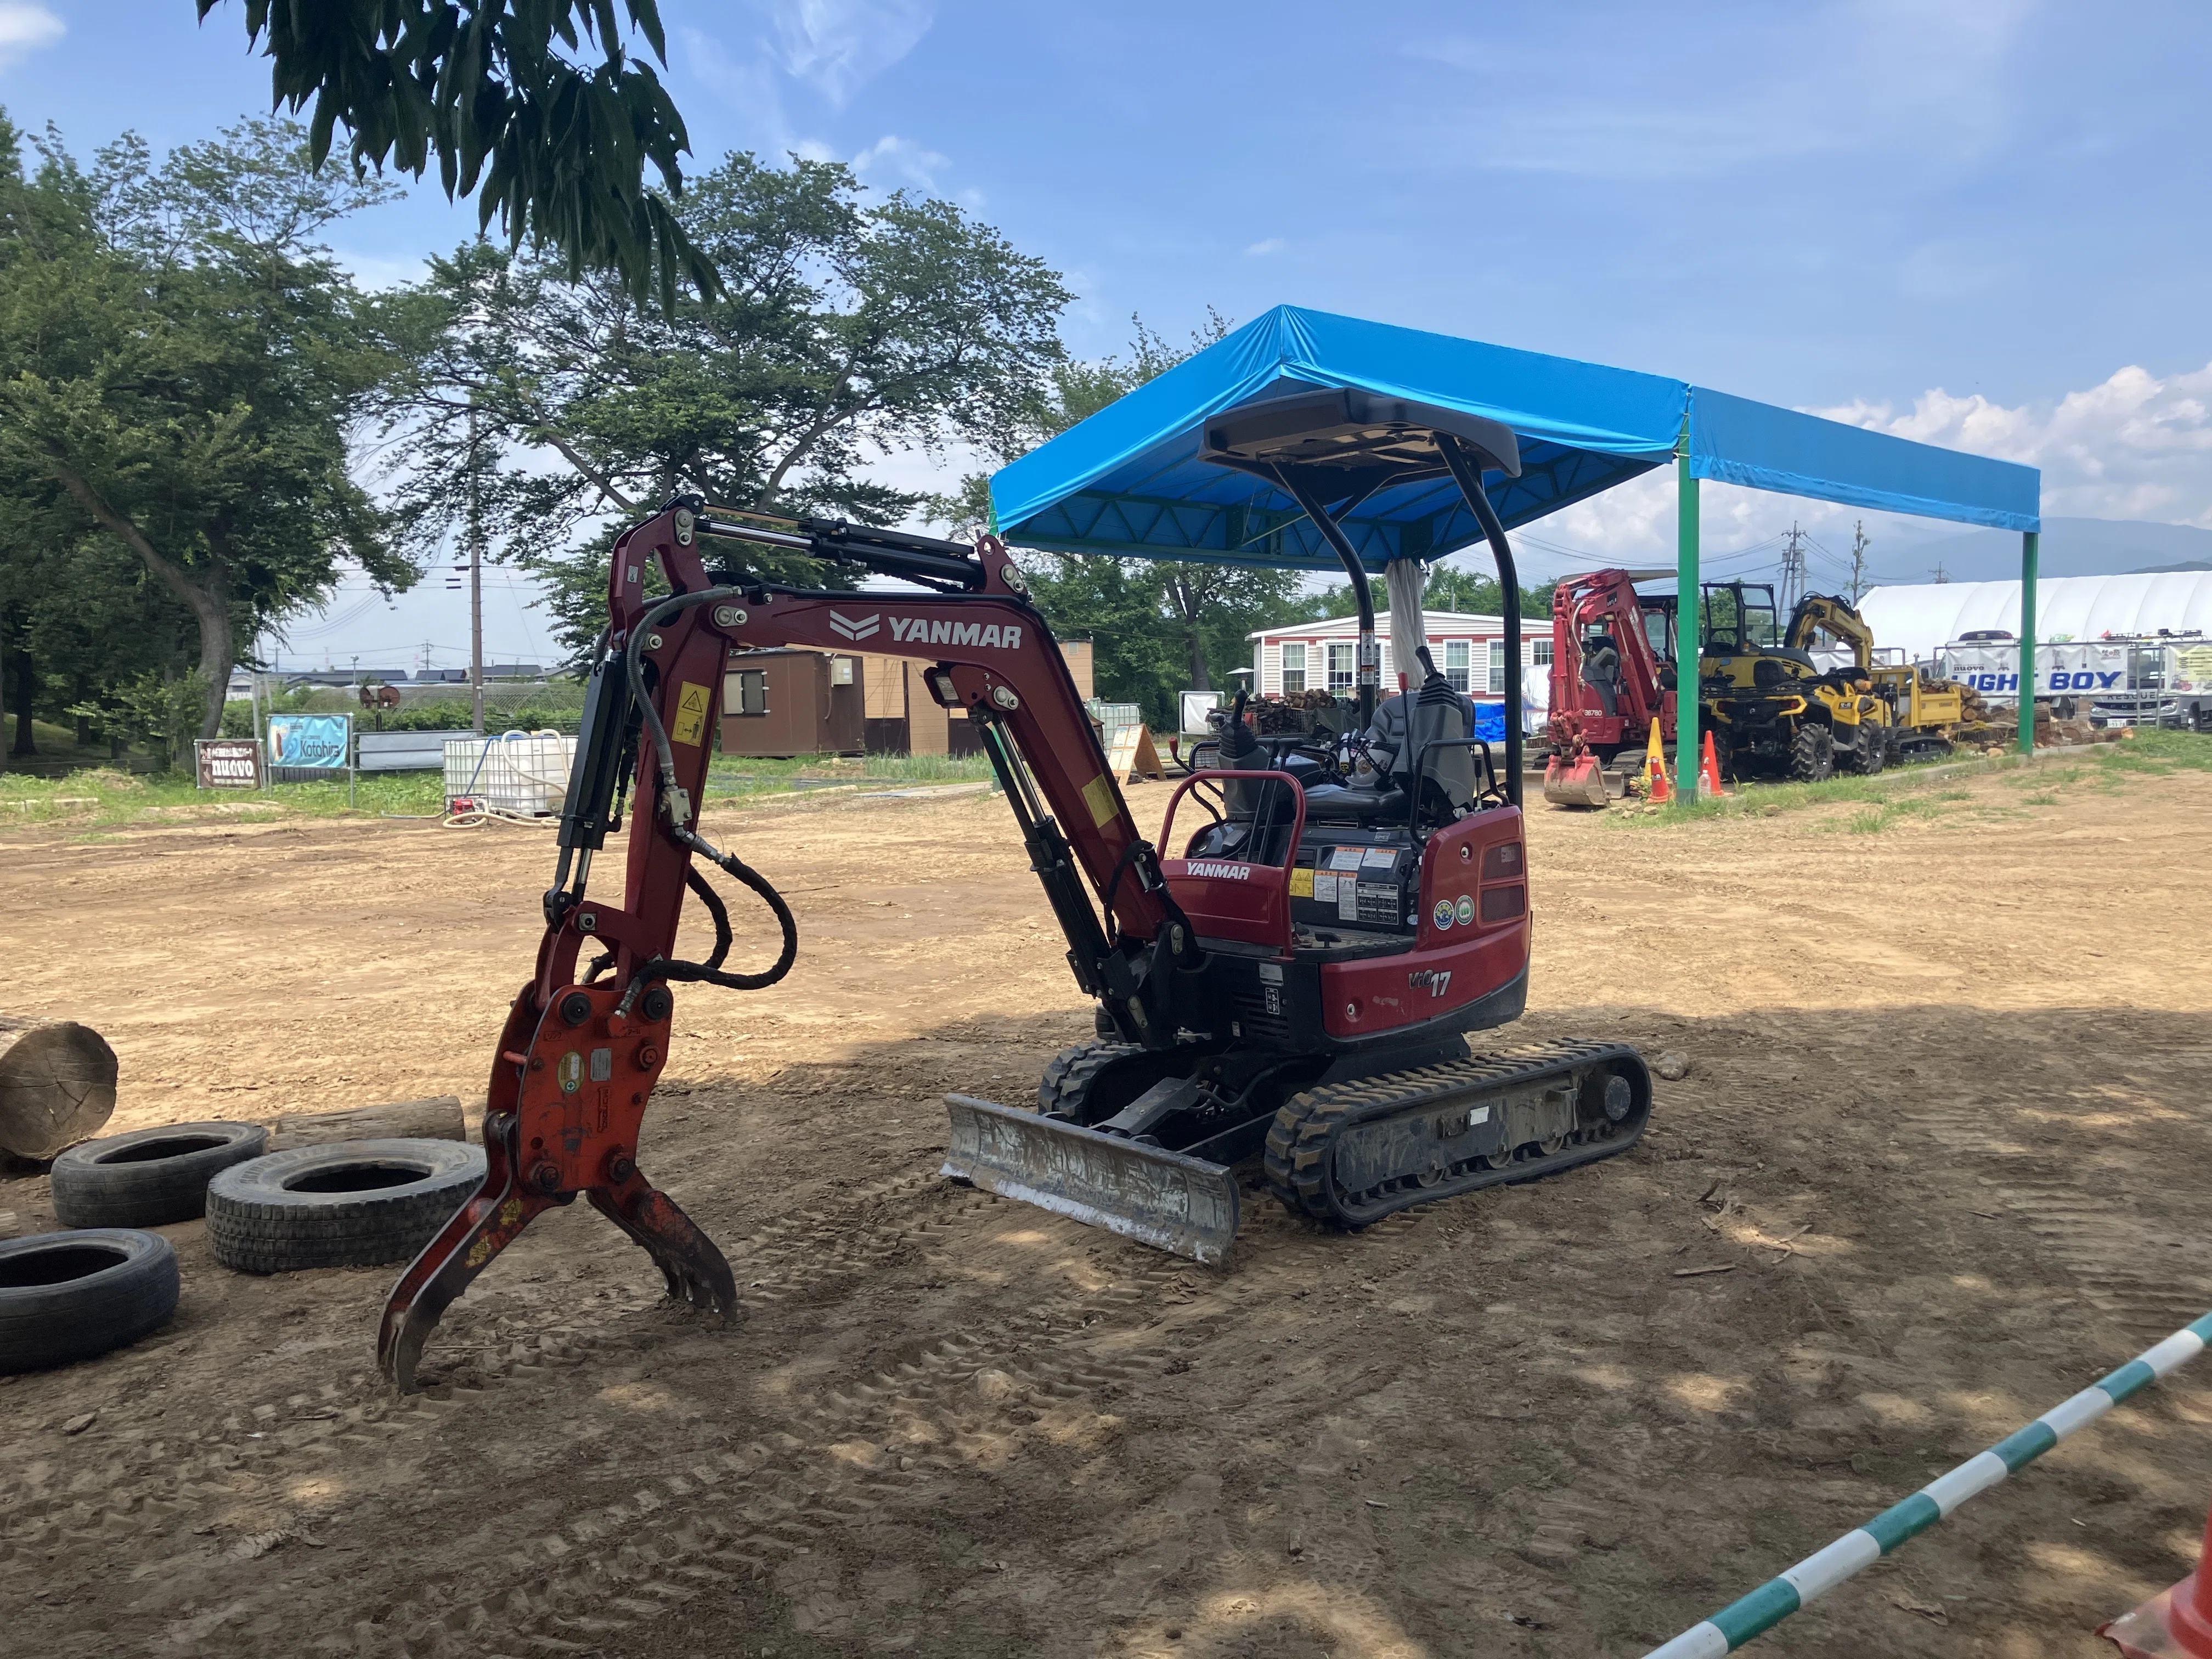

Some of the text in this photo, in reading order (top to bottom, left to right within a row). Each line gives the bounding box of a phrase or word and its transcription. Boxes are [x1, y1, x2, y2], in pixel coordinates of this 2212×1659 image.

[888, 617, 1022, 650] YANMAR
[1951, 671, 2122, 691] IGH BOY
[211, 759, 253, 777] nuovo
[1187, 862, 1251, 881] YANMAR
